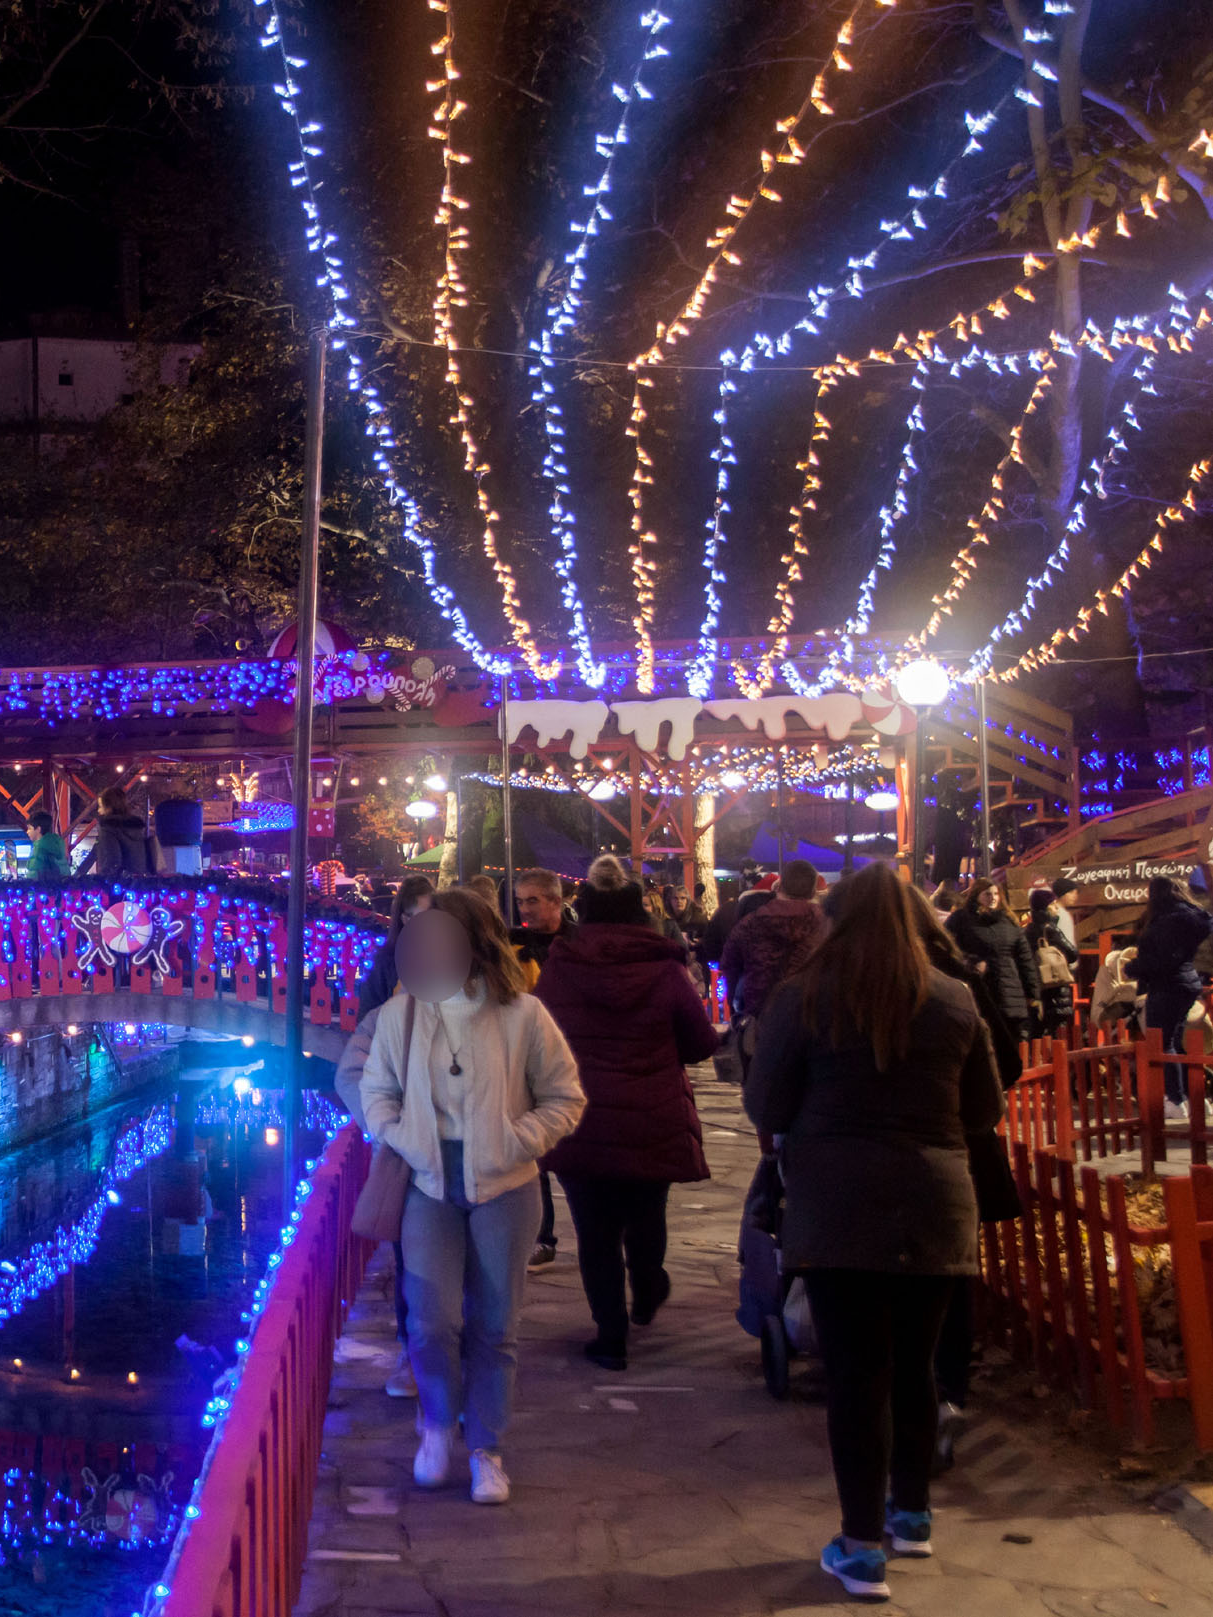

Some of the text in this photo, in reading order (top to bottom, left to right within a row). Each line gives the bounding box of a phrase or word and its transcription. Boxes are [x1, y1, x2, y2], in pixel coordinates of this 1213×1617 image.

[1060, 861, 1198, 885] Ζωγραφική Προσώπο
[1104, 884, 1149, 902] Ονειρο
